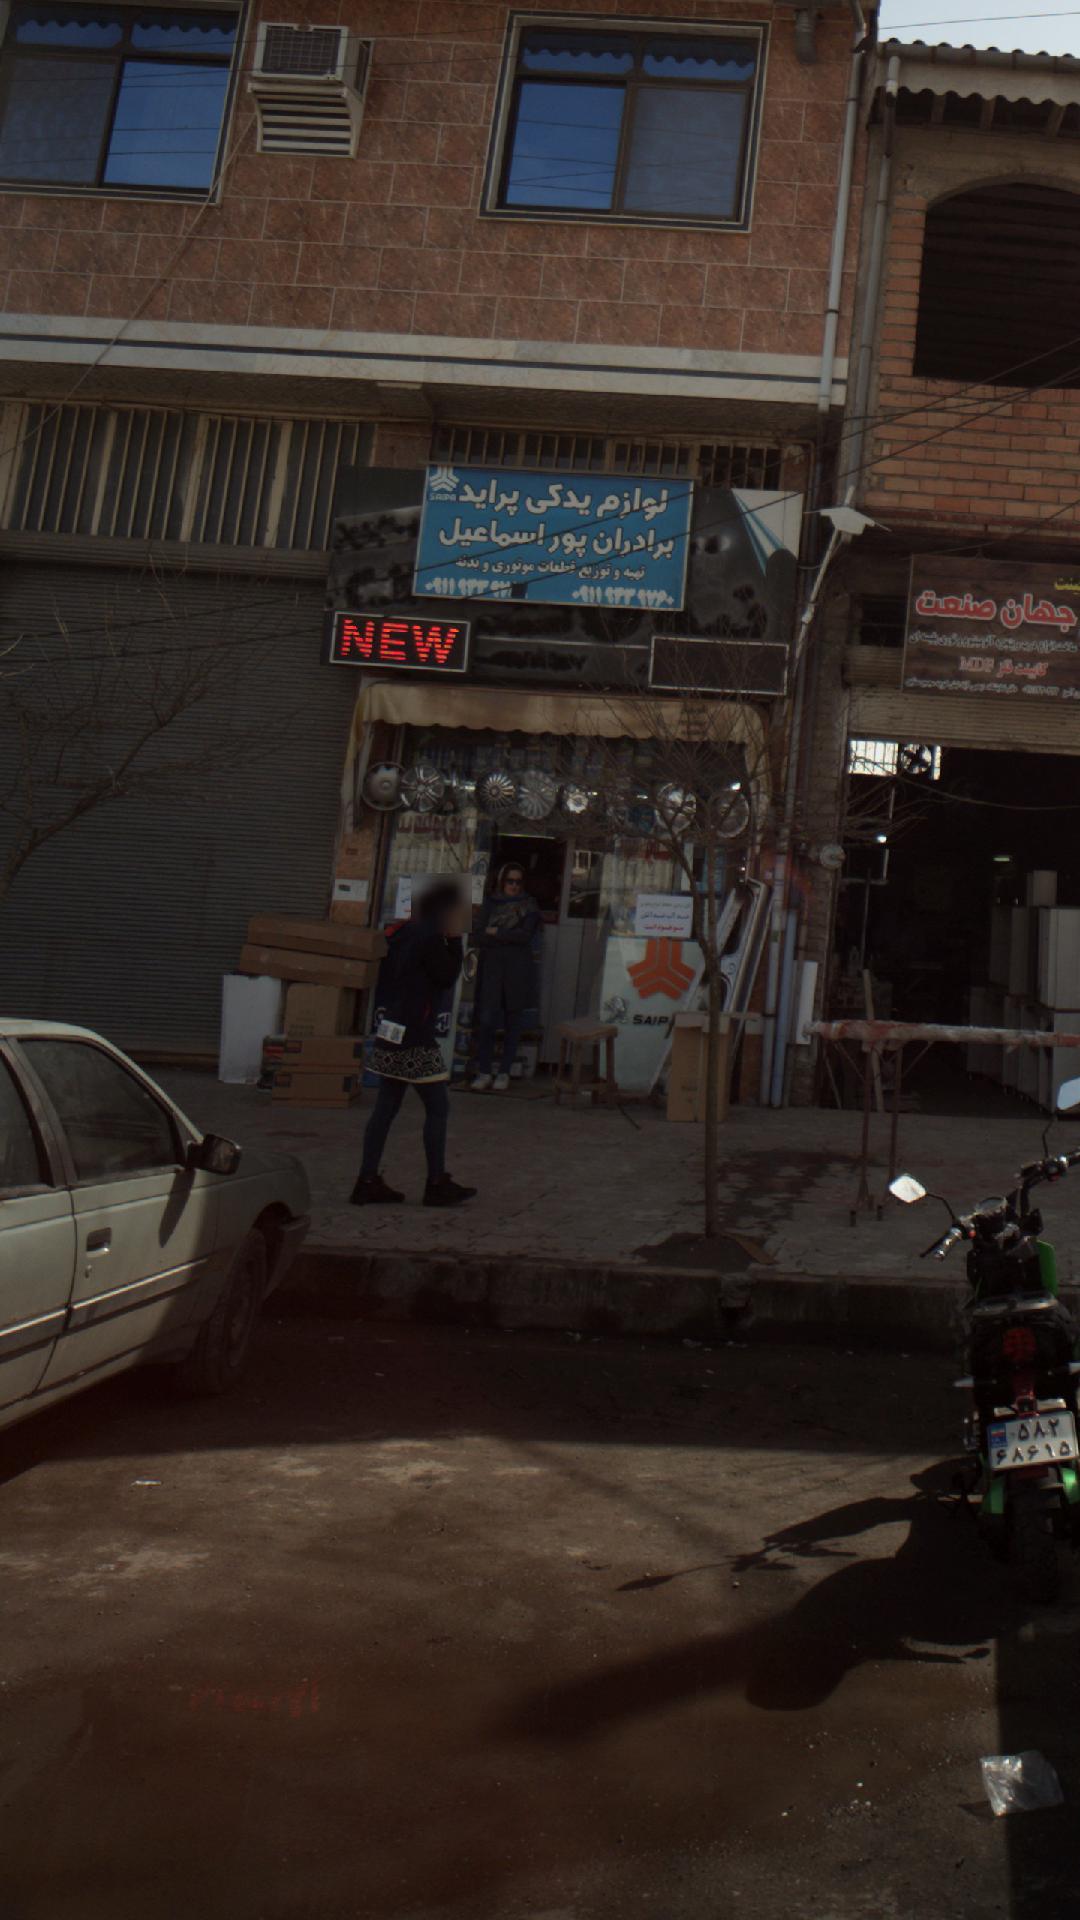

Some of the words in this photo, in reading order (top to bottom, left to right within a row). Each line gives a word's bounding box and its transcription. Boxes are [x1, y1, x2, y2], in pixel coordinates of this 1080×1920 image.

[458, 479, 520, 516] پراید
[526, 484, 592, 516] یدکی
[597, 486, 669, 521] لوازم
[439, 517, 545, 547] اسماعیل
[548, 533, 588, 558] پور
[592, 527, 675, 560] برادران
[537, 560, 577, 574] قطعات
[624, 565, 646, 579] تهیه
[915, 590, 997, 621] صنعت
[1000, 592, 1078, 633] جهان
[340, 618, 460, 664] NEW
[632, 1013, 670, 1026] SAIP
[1018, 1418, 1059, 1441] ۵۸۲
